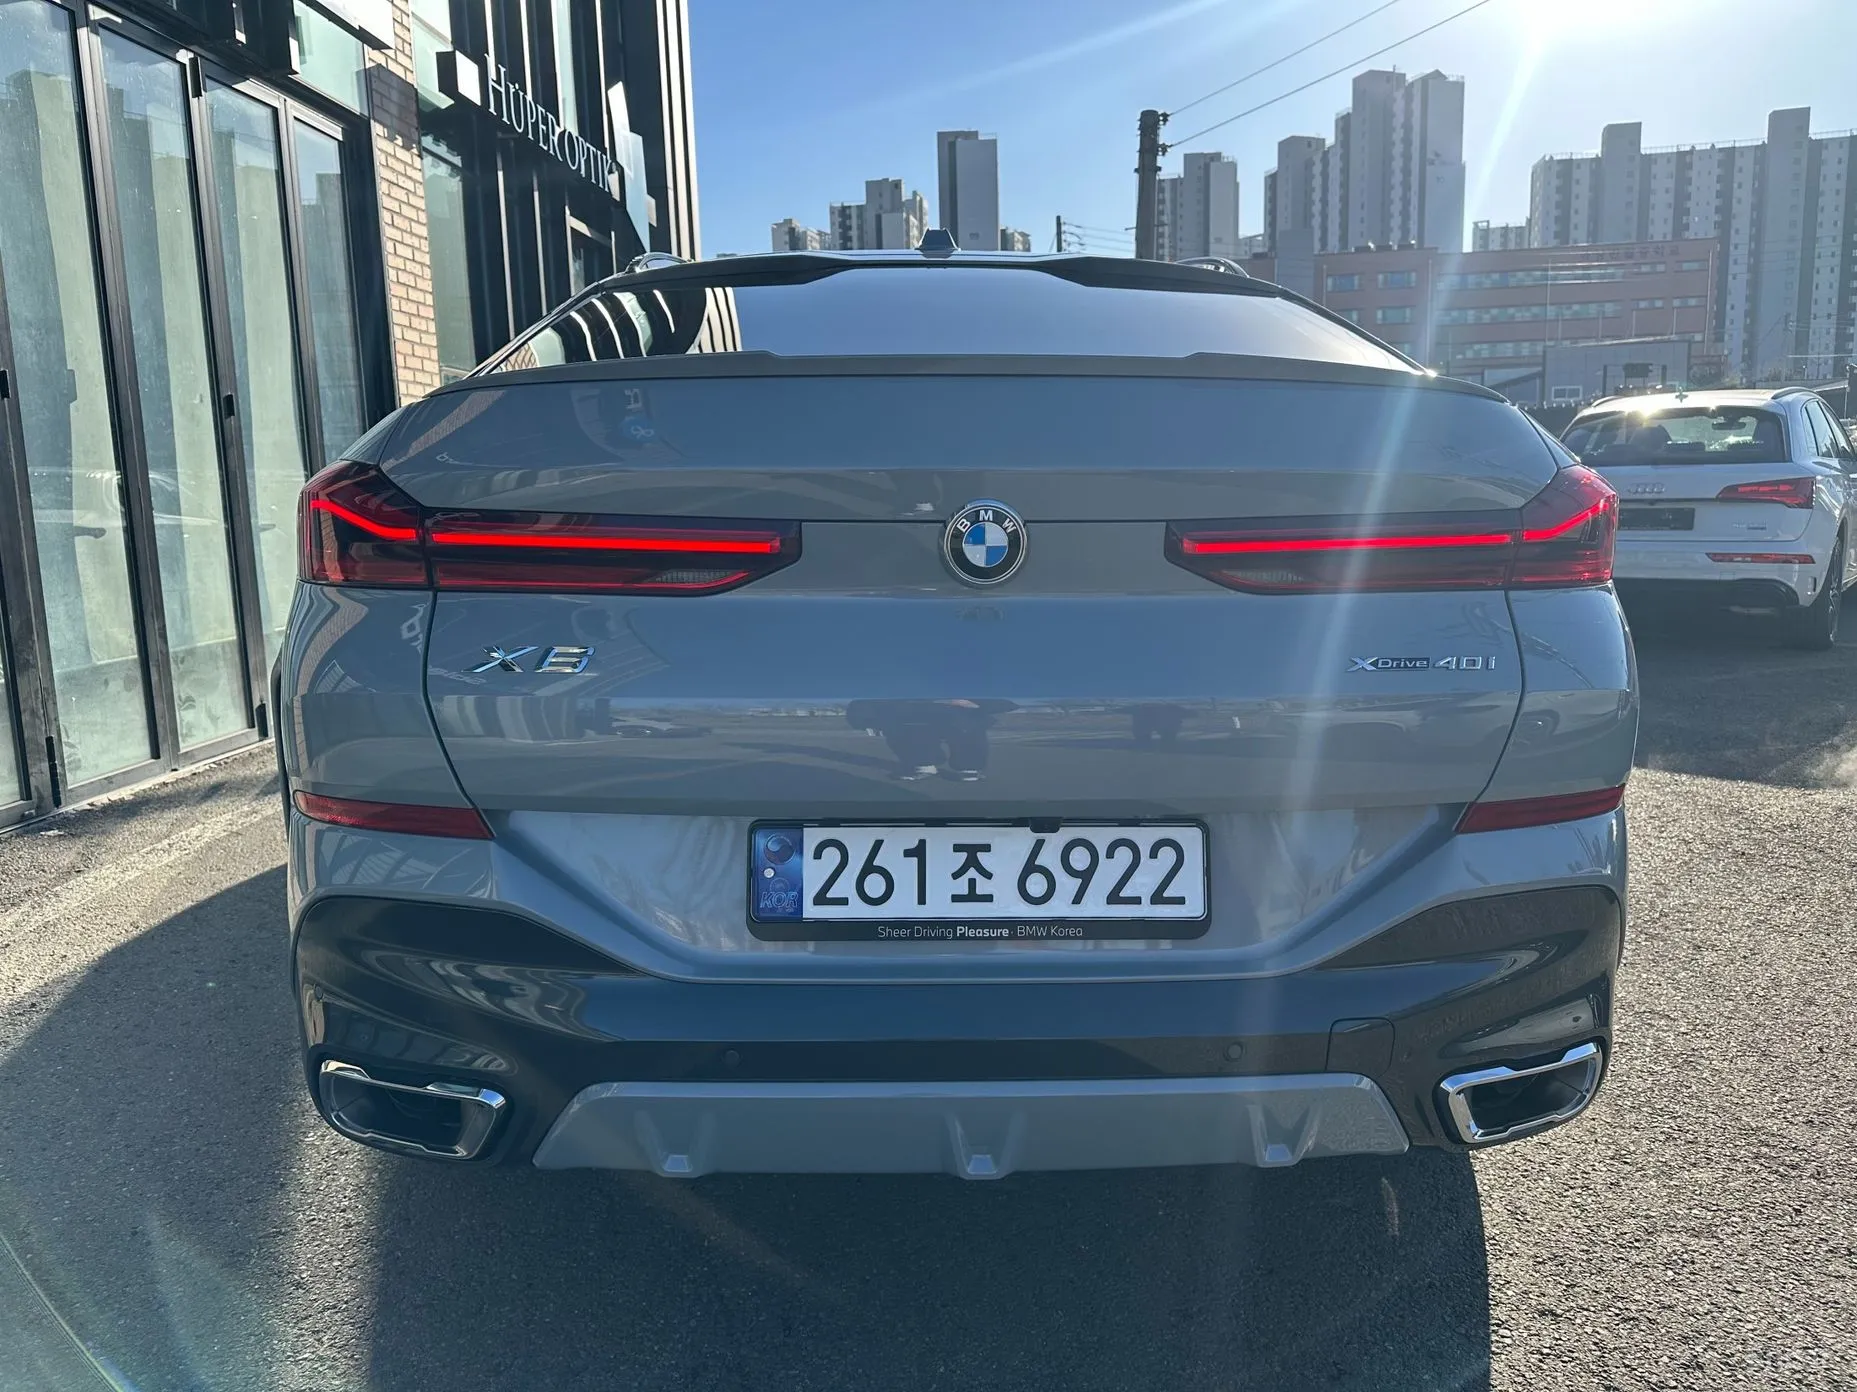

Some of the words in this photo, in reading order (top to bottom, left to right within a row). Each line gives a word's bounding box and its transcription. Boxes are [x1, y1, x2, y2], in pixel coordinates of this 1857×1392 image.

[485, 53, 563, 161] HÜPER
[564, 127, 612, 193] OPTIK
[957, 509, 1017, 534] BMW
[460, 645, 596, 673] X6
[1017, 838, 1187, 906] 6922
[759, 890, 799, 909] KOR
[877, 926, 911, 938] Sheer
[914, 926, 953, 940] Driving
[956, 926, 1009, 938] Pleasure
[1017, 925, 1047, 937] BMW
[1050, 926, 1083, 937] Korea
